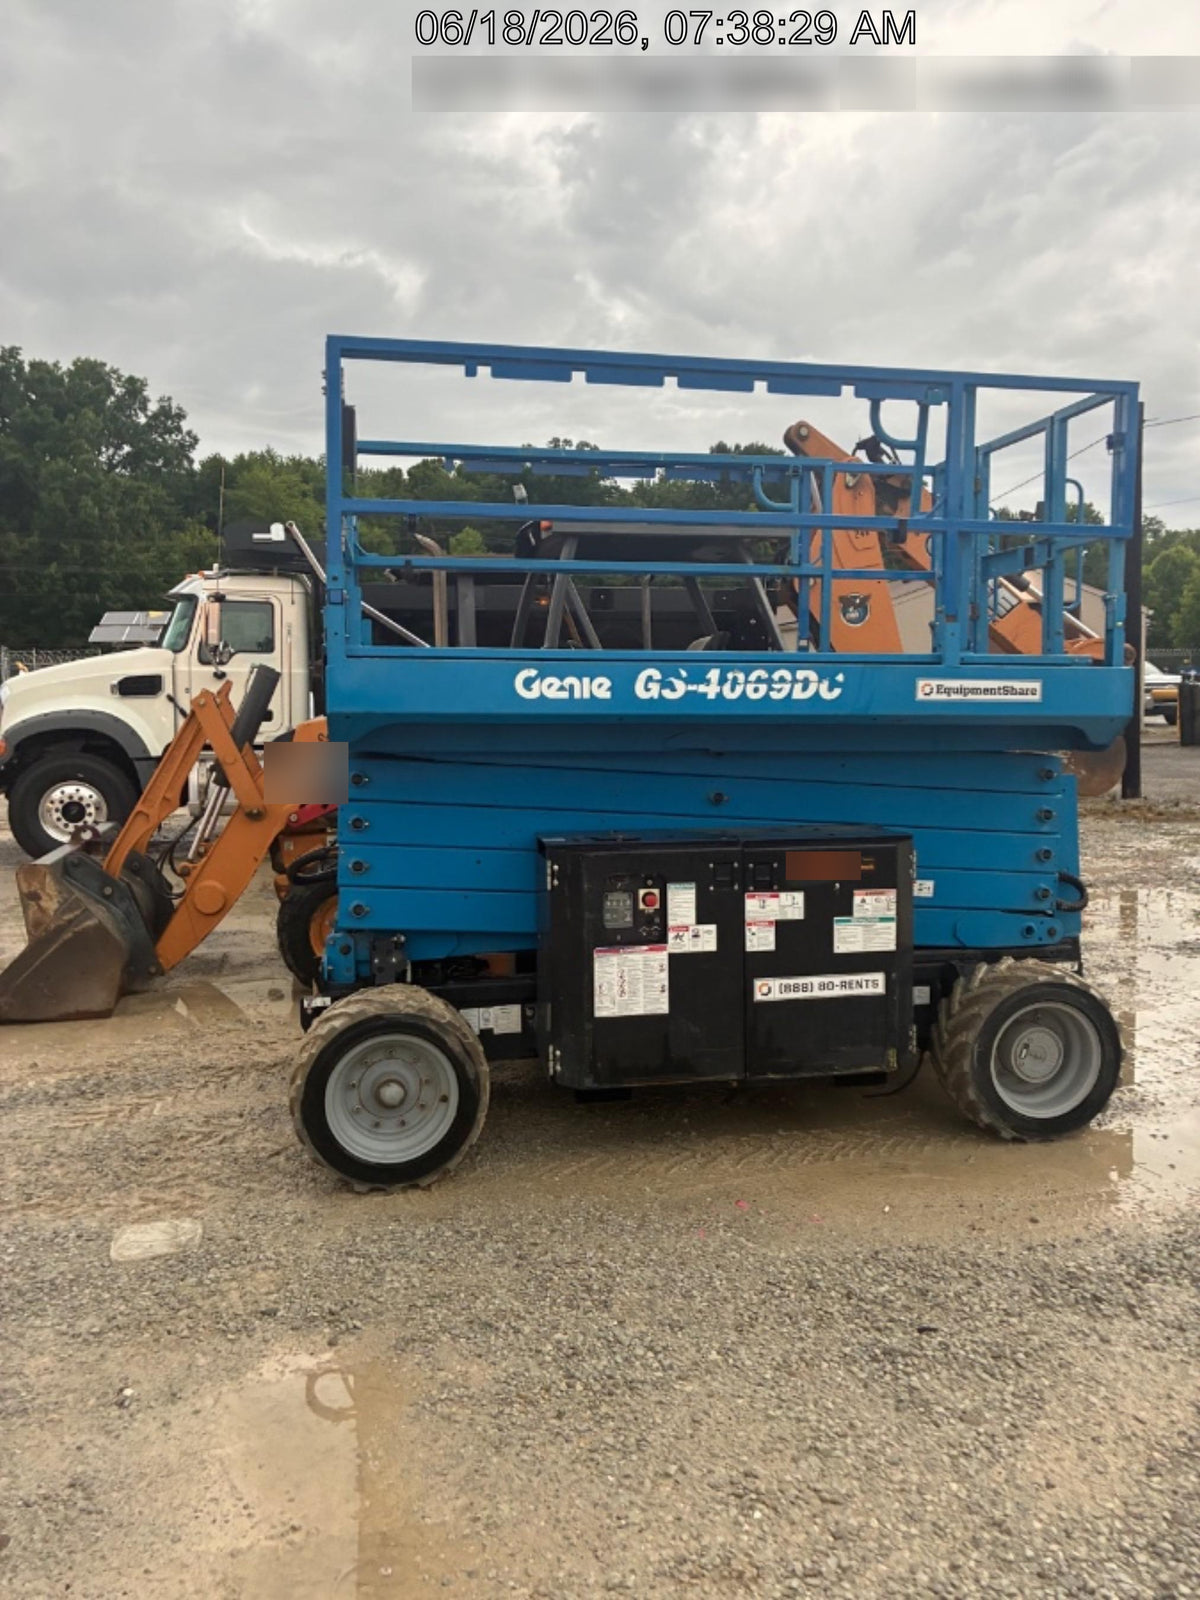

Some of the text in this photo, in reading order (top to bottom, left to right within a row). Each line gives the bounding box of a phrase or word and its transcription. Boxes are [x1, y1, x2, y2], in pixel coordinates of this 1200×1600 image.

[514, 668, 612, 700] Genie
[936, 684, 1038, 697] EquipmentShare
[780, 979, 880, 994] (888) 80-RENTS
